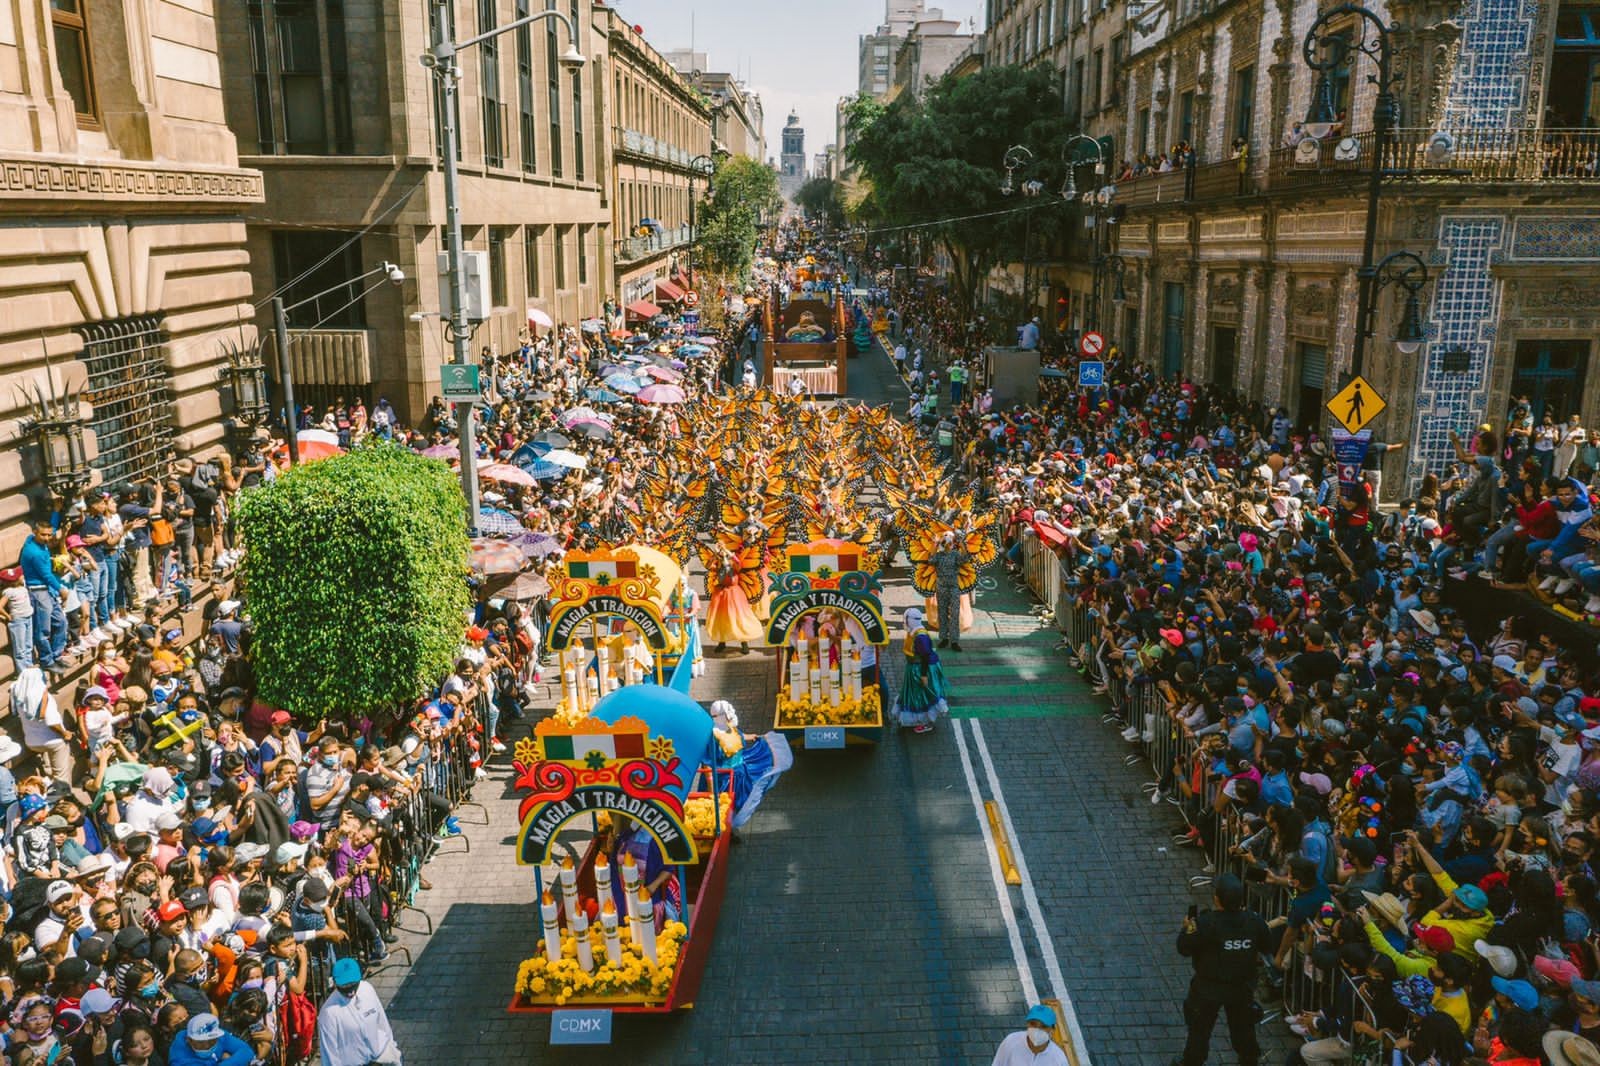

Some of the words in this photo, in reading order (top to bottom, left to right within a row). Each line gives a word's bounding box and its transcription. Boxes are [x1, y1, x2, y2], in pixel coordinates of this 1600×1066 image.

[556, 606, 590, 637] MAGIA
[588, 600, 599, 613] Y
[601, 599, 659, 637] TRADICION
[774, 601, 809, 631] MAGIA
[808, 593, 818, 606] Y
[820, 592, 878, 630] TRADICION
[809, 730, 840, 741] CDMX
[530, 800, 576, 846] MAGIA
[575, 793, 587, 809] Y
[592, 791, 680, 843] TRADICION
[1224, 939, 1252, 951] SSC
[559, 1018, 602, 1032] CDMX
